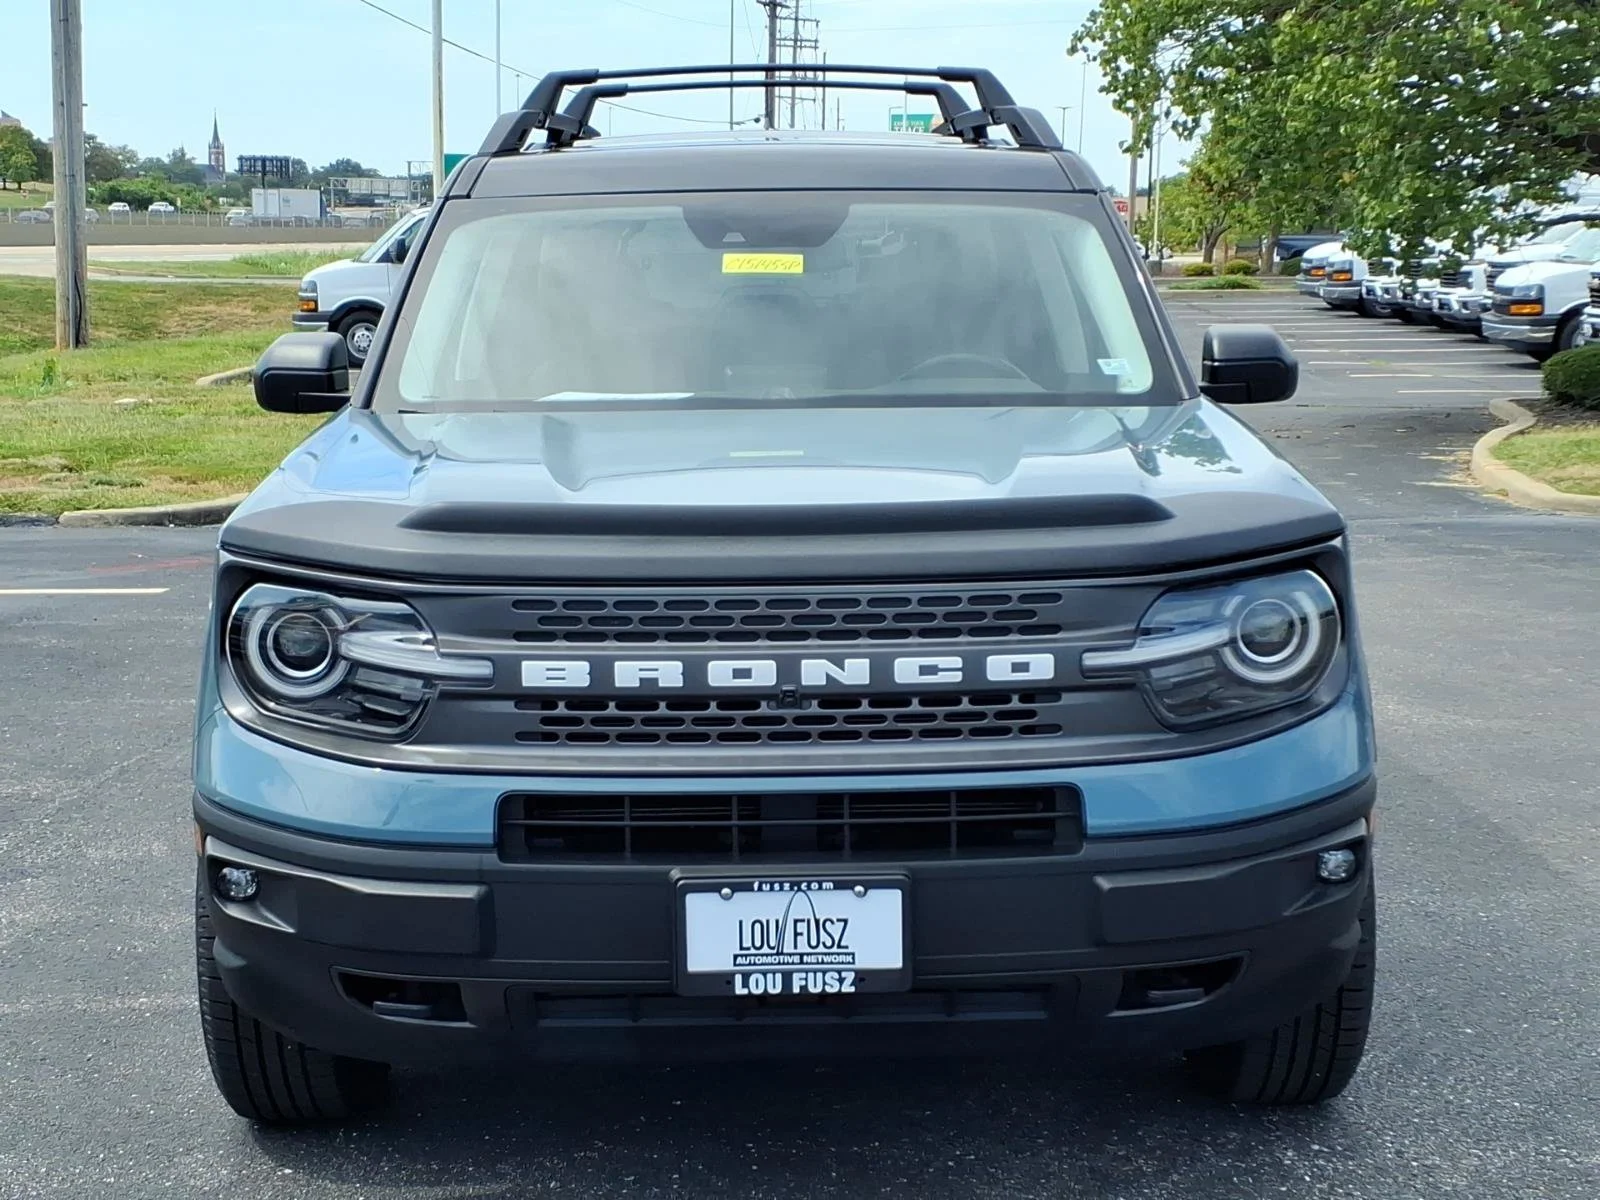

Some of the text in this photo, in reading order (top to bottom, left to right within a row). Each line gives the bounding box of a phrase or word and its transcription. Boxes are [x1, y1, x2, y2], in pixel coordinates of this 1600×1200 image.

[521, 653, 1055, 688] BRONCO
[753, 880, 834, 892] fusz.com
[738, 918, 849, 952] LOU FUSZ
[735, 953, 854, 965] AUTOMOTIVE NETWORK
[734, 971, 856, 995] LOU FUSZ
